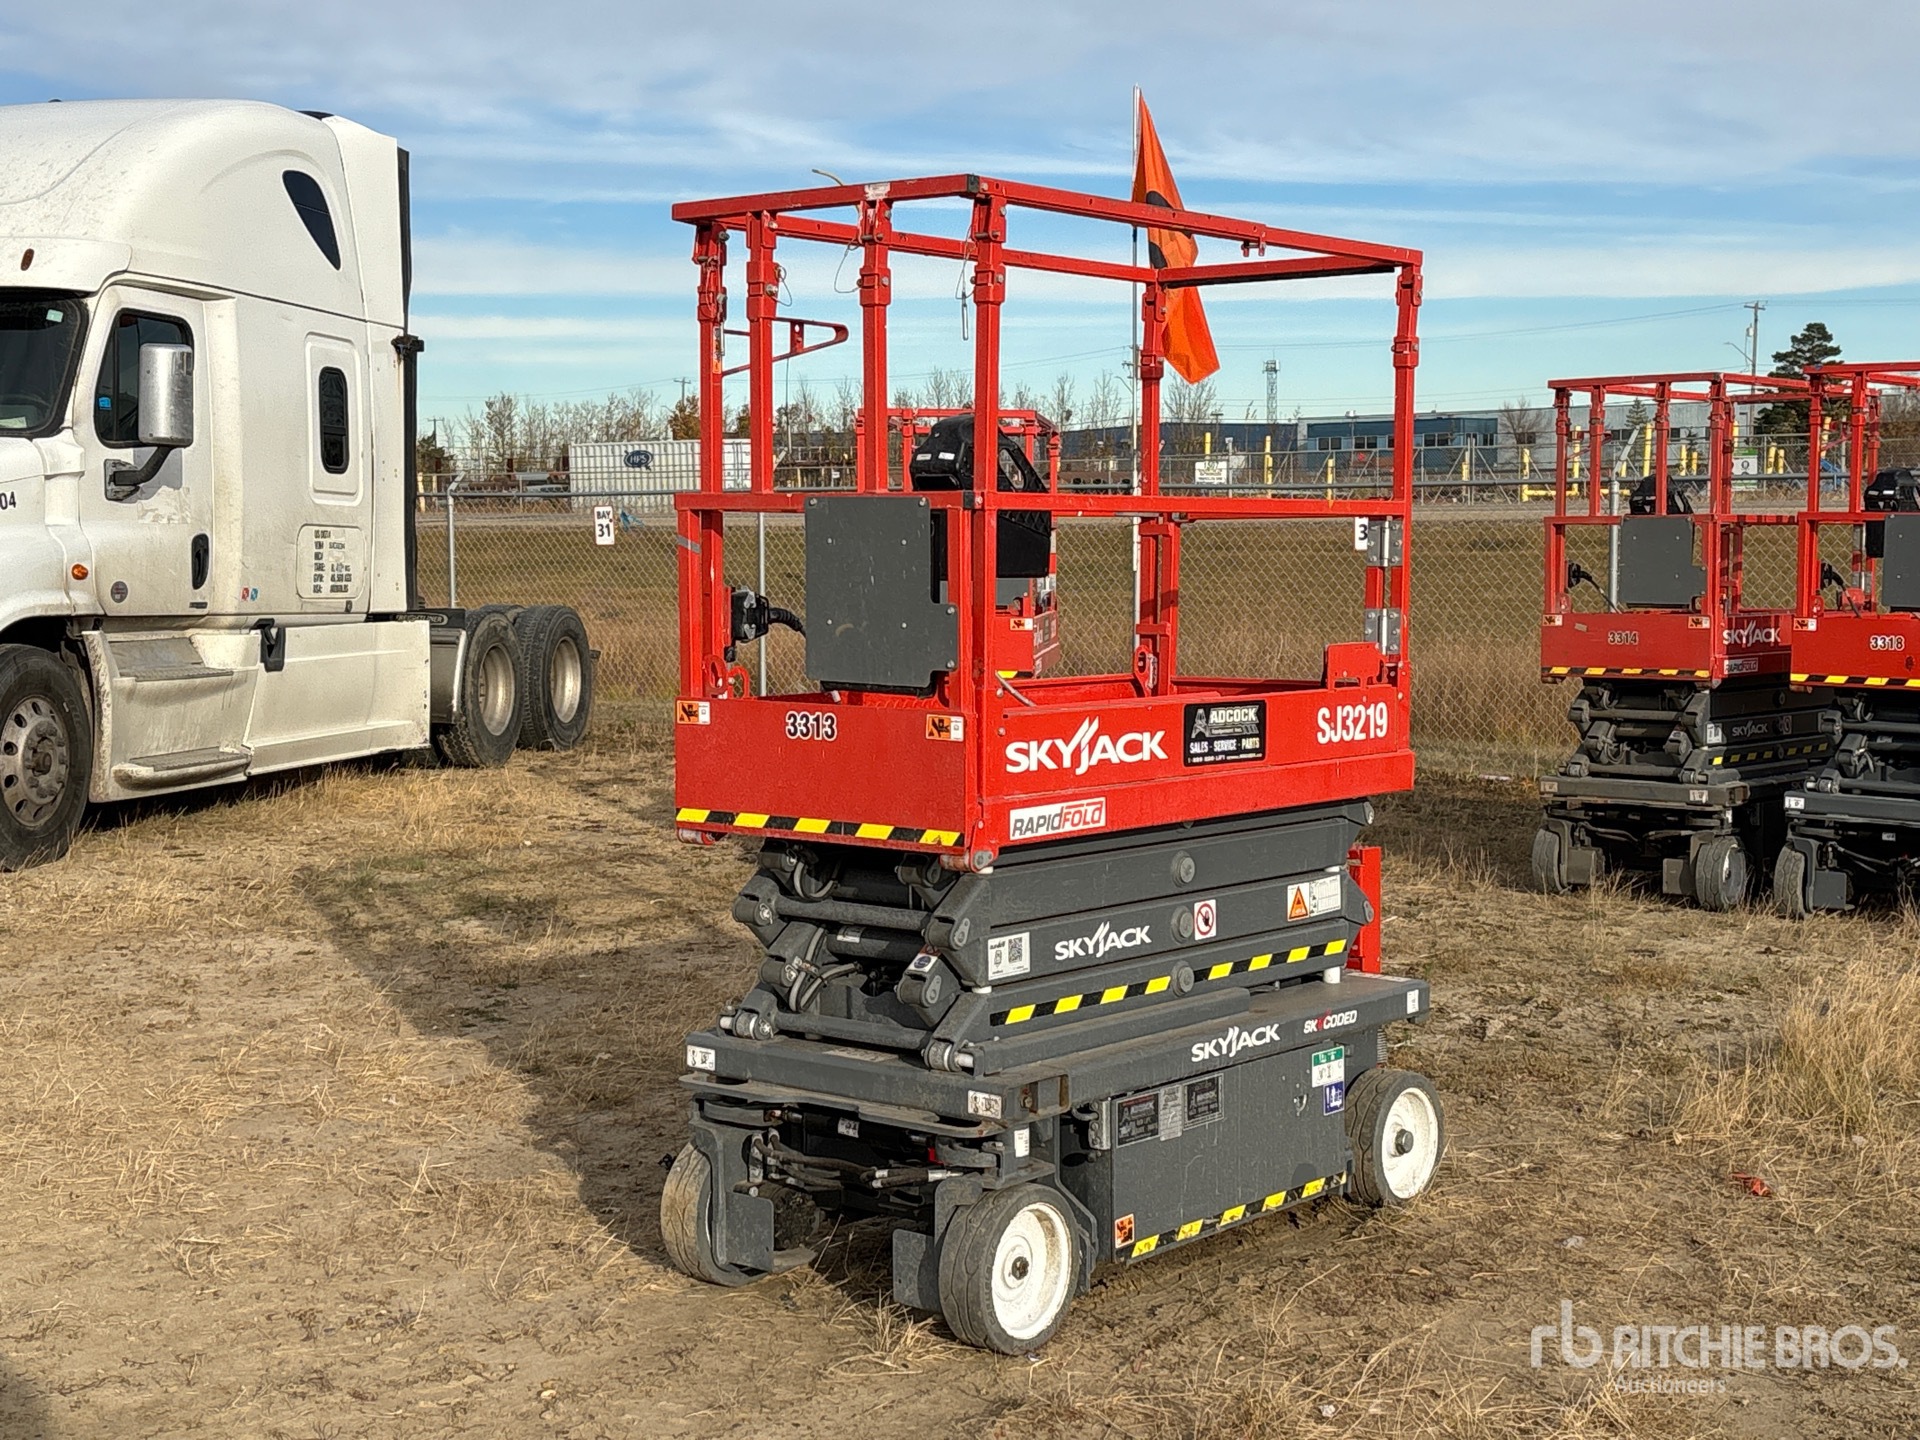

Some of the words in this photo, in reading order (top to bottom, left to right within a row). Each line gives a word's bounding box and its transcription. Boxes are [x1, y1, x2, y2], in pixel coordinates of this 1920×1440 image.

[596, 510, 611, 519] BAY
[597, 523, 611, 538] 31
[1607, 630, 1639, 646] 3314
[1722, 620, 1782, 647] SKYJACK
[1870, 635, 1905, 651] 3318
[1209, 707, 1257, 725] ADCOCK
[1316, 701, 1388, 745] SJ3219
[785, 710, 838, 742] 3313
[1732, 720, 1769, 738] SKYJACK
[1005, 715, 1169, 776] SKYJACK
[1189, 741, 1209, 754] SALES
[1213, 738, 1237, 752] SERVICE
[1241, 737, 1260, 750] PARTS
[1054, 921, 1153, 961] SKYJACK
[1191, 1023, 1281, 1063] SKYJACK
